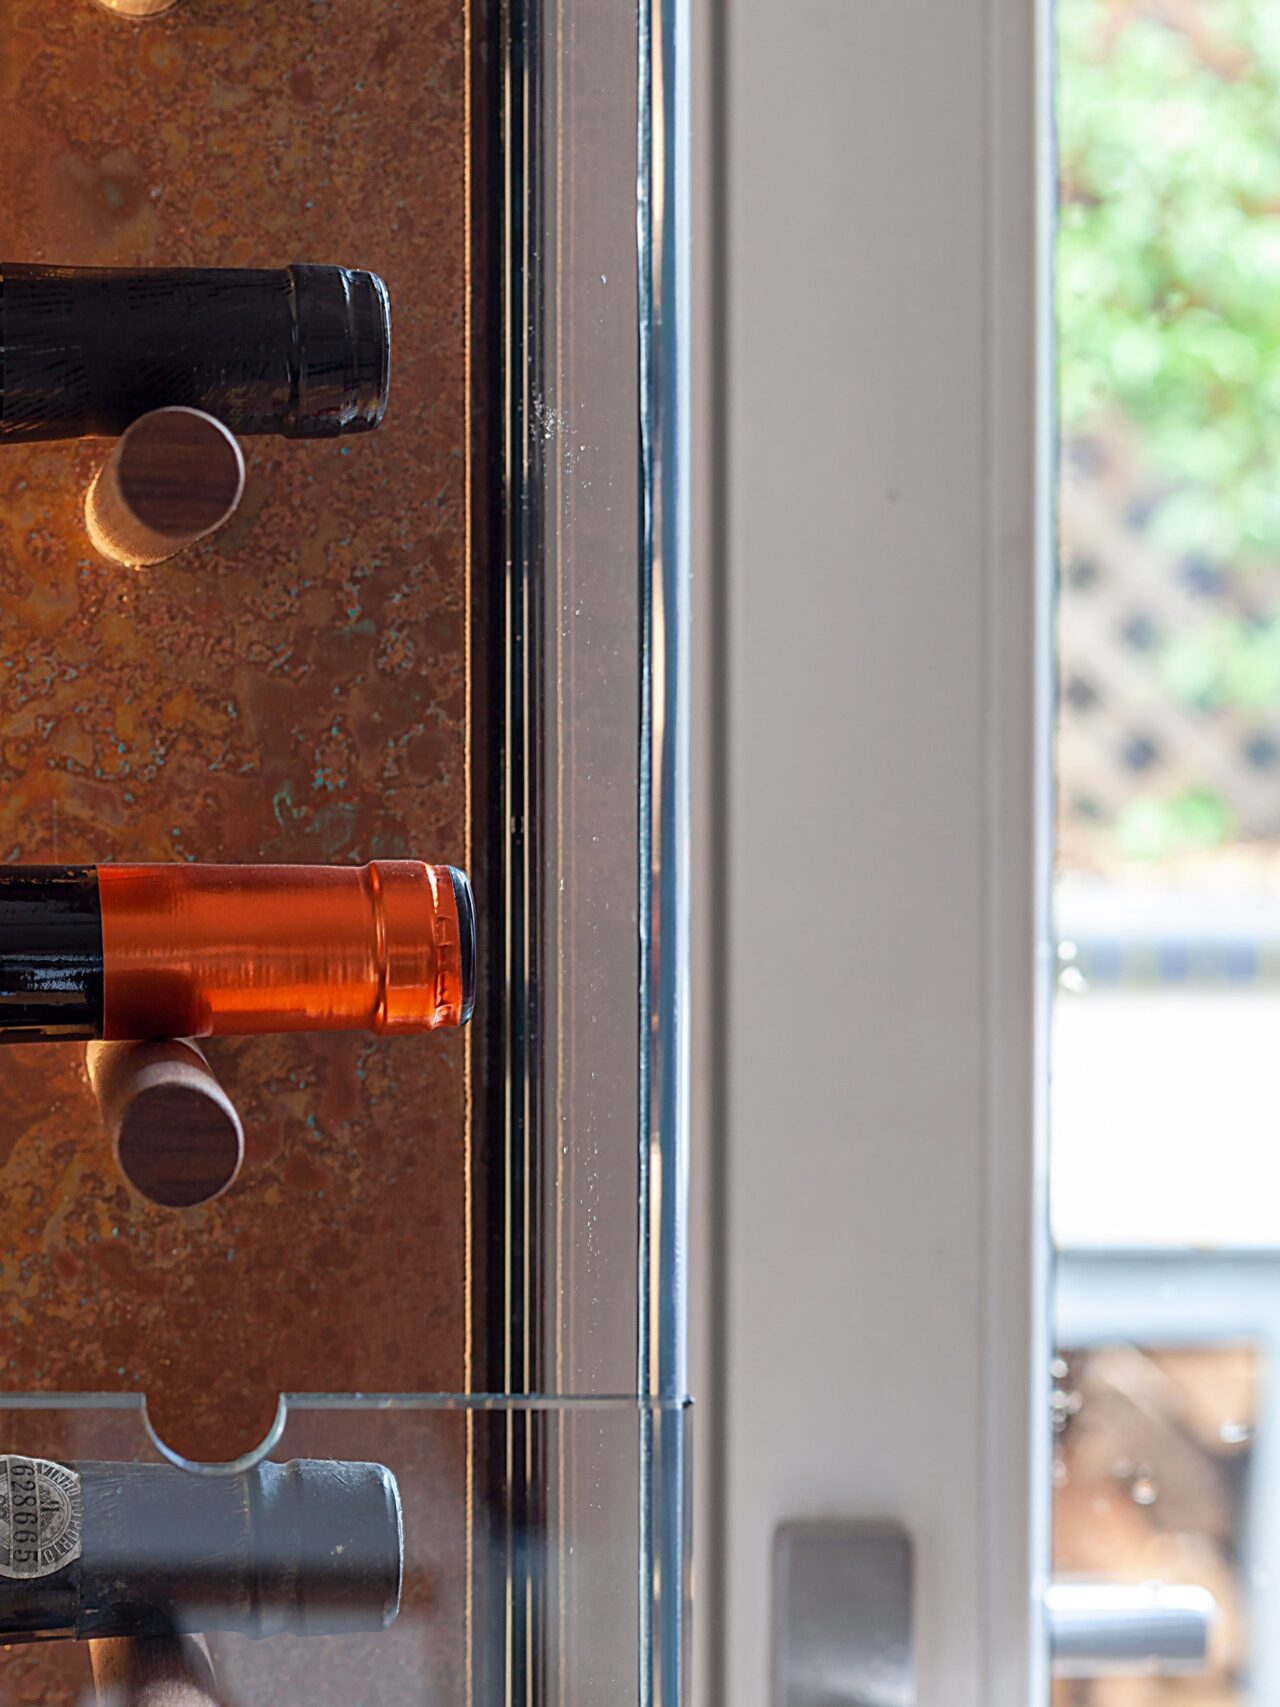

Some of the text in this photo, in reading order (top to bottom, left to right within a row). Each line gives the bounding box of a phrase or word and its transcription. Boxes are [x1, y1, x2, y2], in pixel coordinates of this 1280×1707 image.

[41, 1464, 81, 1497] VINHO
[10, 1465, 39, 1563] 628665
[44, 1520, 81, 1564] PORTO
